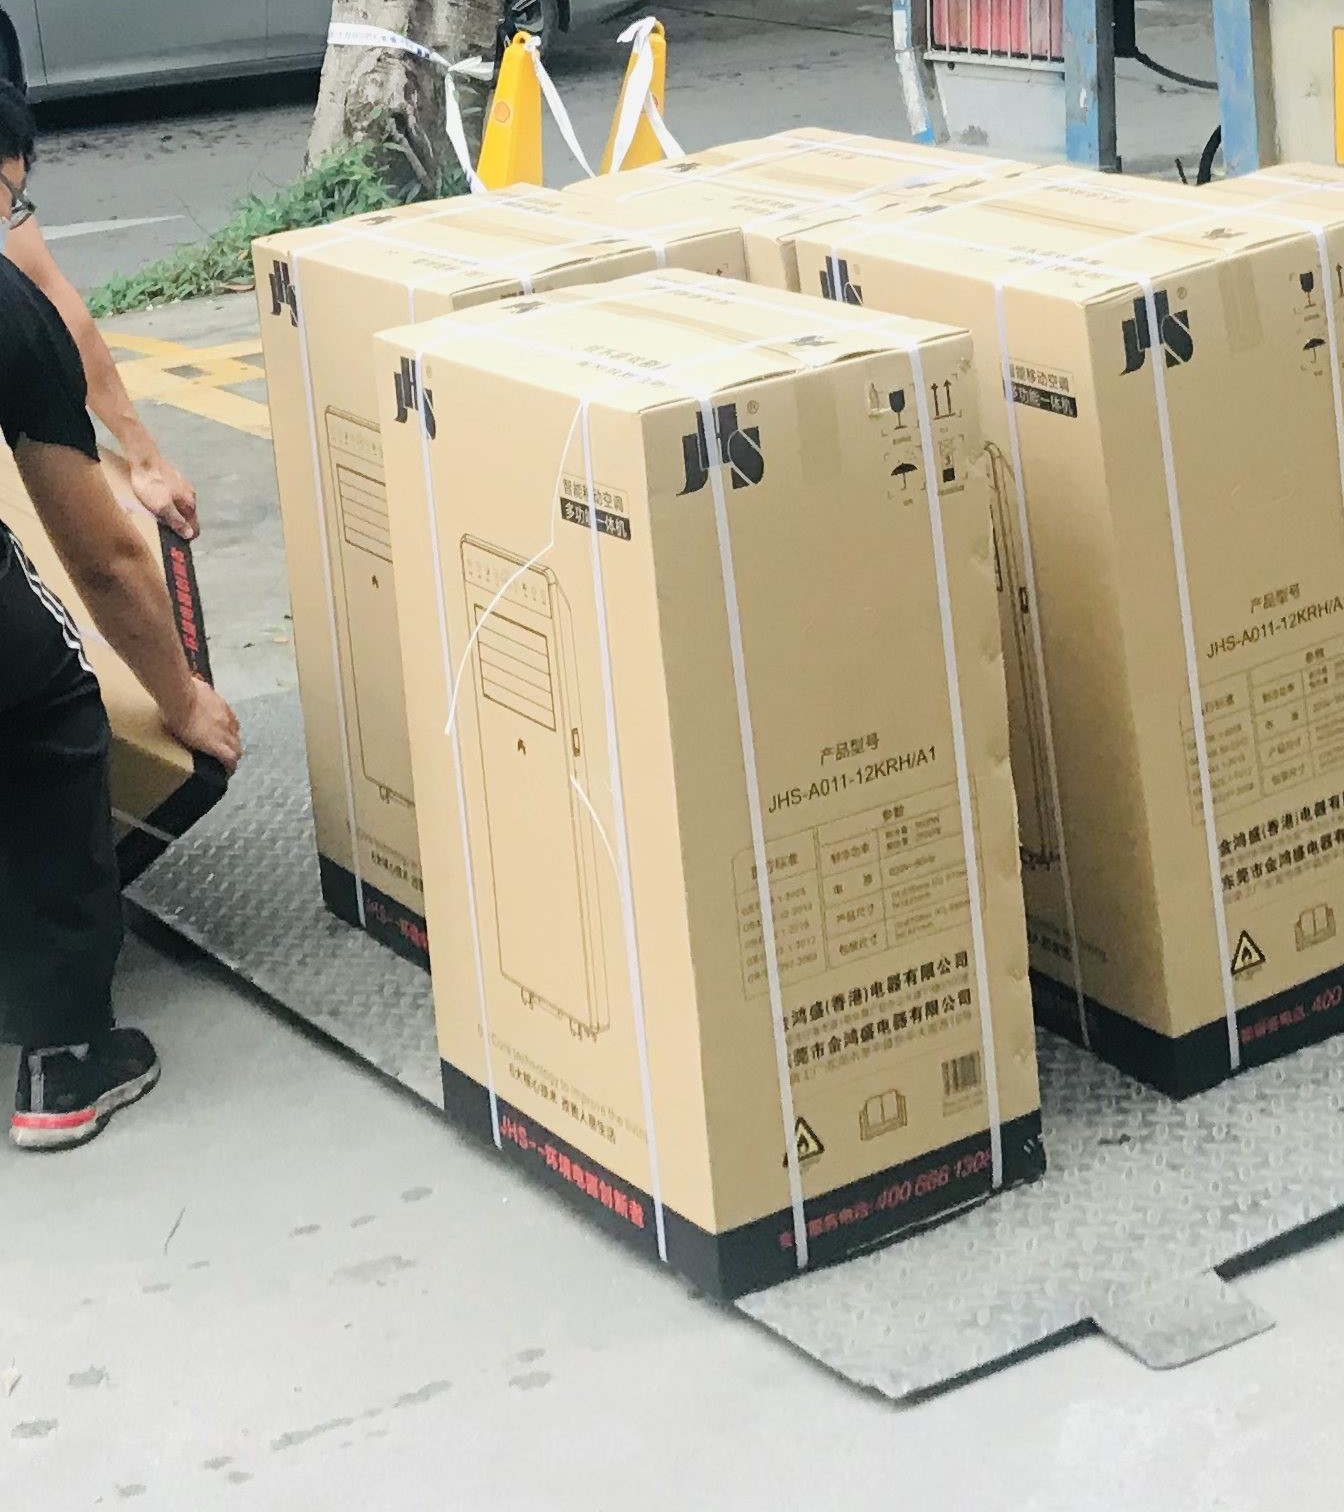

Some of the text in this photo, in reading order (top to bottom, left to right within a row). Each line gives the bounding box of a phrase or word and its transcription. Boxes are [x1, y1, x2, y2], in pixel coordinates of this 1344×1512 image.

[1119, 289, 1195, 376] JHS
[676, 402, 765, 496] JHS
[768, 746, 938, 814] JHS-A011-12KRH/A1
[821, 733, 880, 765] 产品型号
[788, 988, 972, 1069] 莞市金鸿盛电器有限公司
